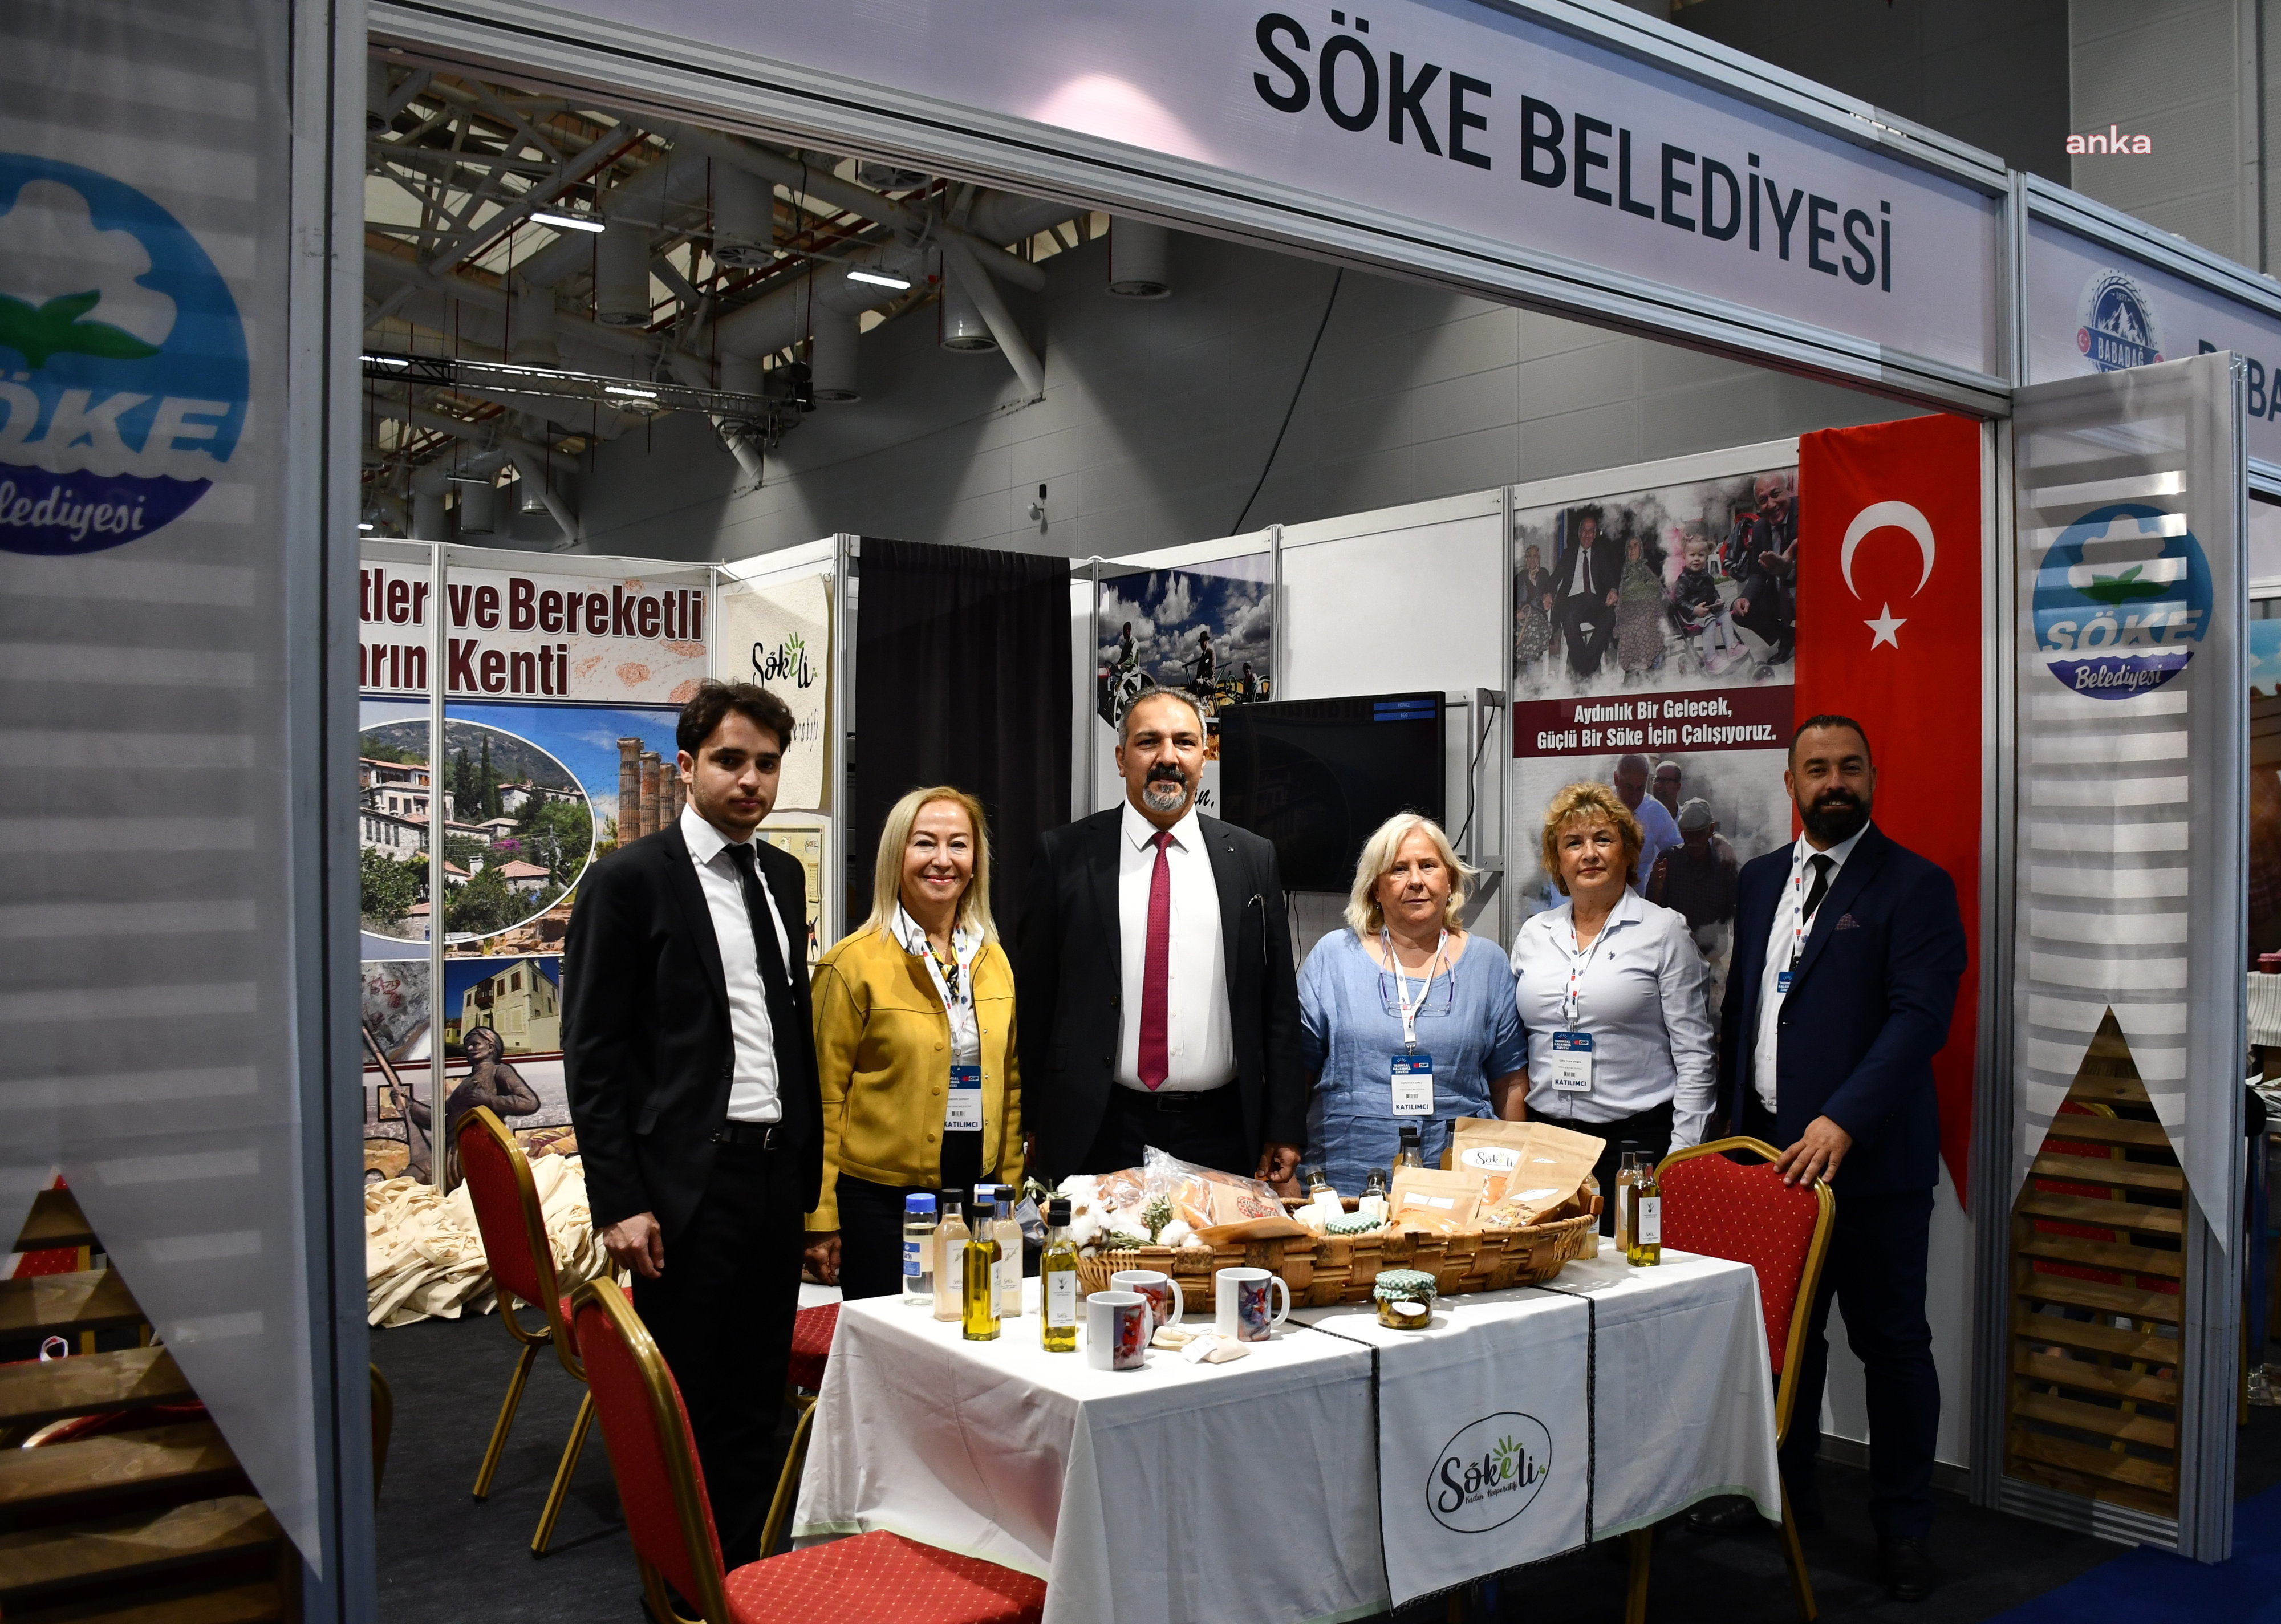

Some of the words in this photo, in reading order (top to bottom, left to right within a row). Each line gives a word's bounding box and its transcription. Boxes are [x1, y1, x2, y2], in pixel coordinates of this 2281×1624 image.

[1254, 9, 1491, 170] SÖKE
[1521, 95, 1890, 293] BELEDİYESİ
[448, 584, 500, 629] ve
[509, 578, 703, 640] Bereketli
[2041, 609, 2203, 651] SÖKE
[448, 638, 568, 695] Kenti
[2075, 664, 2162, 692] Belediyesi
[1574, 703, 1633, 724] Aydınlık
[1637, 701, 1659, 720] Bir
[1663, 697, 1732, 718] Gelecek,
[1537, 729, 1577, 750] Güçlü
[1582, 729, 1602, 747] Bir
[1606, 727, 1643, 746] Söke
[1648, 722, 1677, 747] İçin
[1682, 724, 1776, 746] Çalışıyoruz.
[1438, 1447, 1540, 1513] Sökeli
